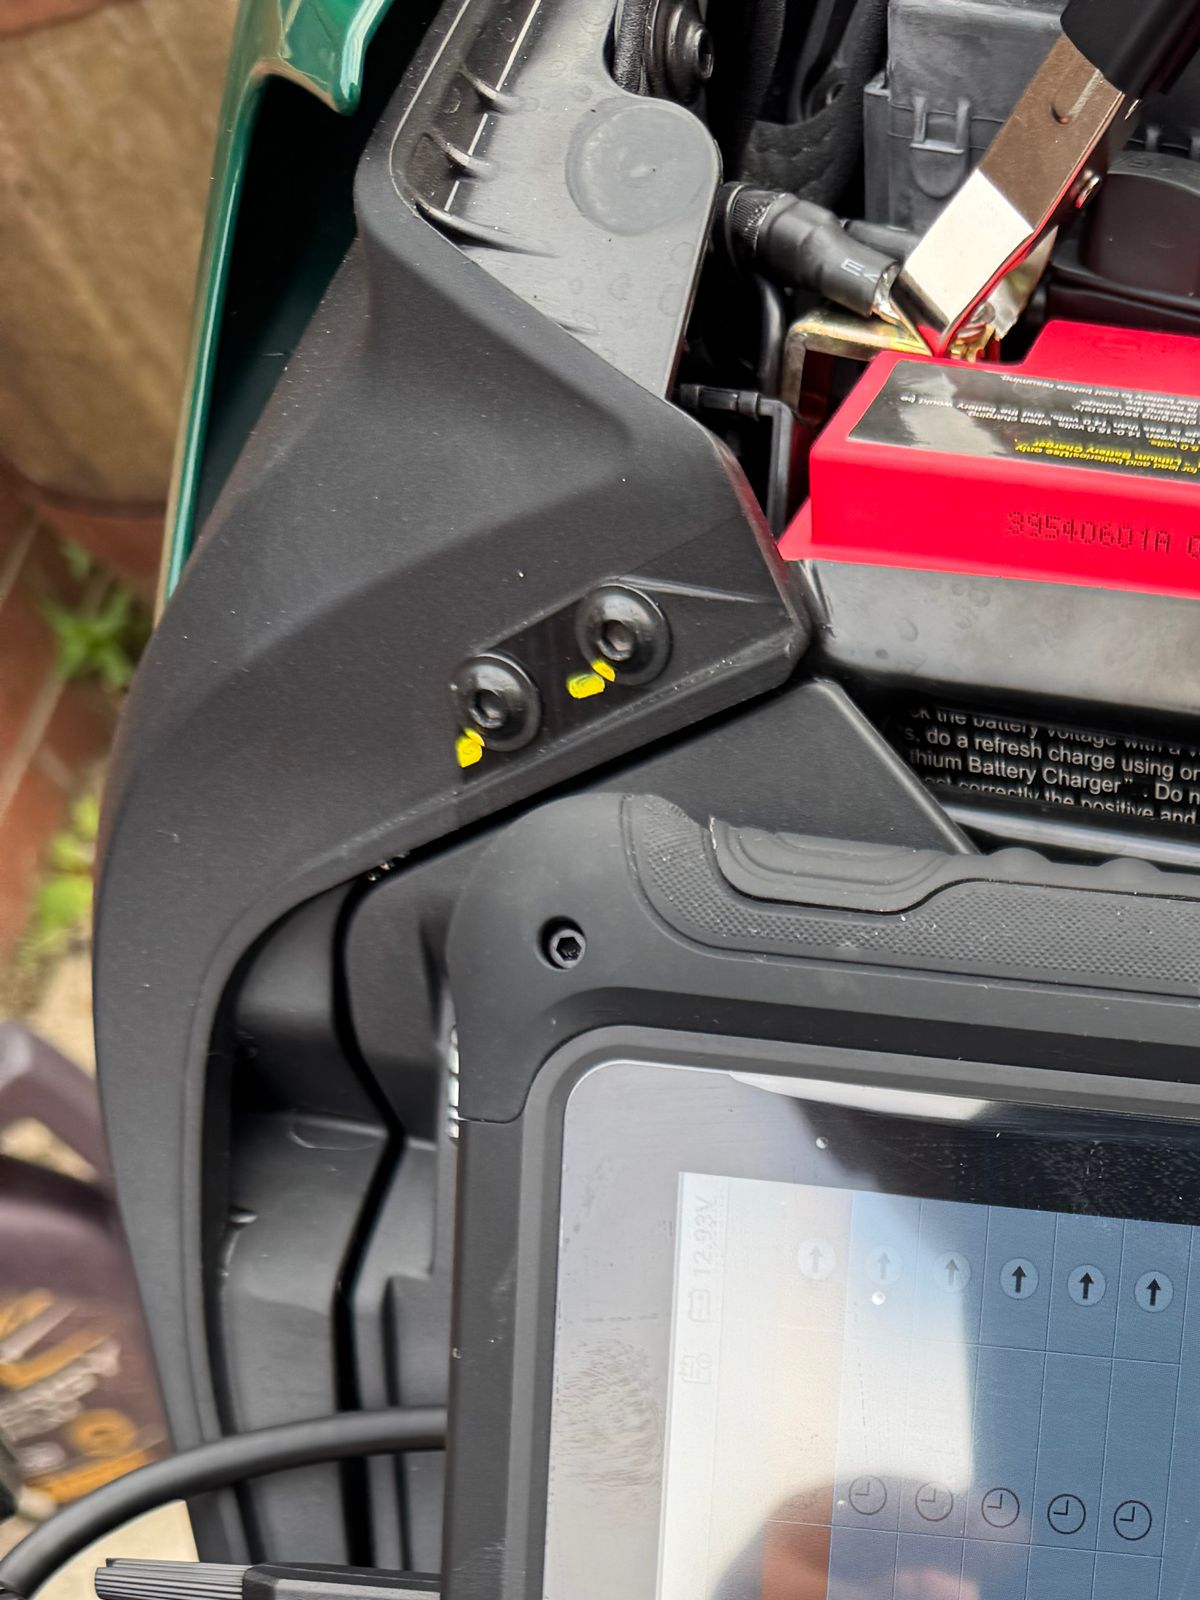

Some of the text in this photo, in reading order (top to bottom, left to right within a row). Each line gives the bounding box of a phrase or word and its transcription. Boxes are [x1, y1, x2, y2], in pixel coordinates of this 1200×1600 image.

[918, 397, 953, 408] would
[956, 401, 995, 412] battery
[1019, 417, 1051, 426] when
[1144, 432, 1195, 444] between
[1014, 444, 1042, 454] only
[1031, 440, 1082, 452] Charger
[1085, 446, 1131, 459] Battery
[1124, 459, 1150, 468] acid
[1133, 453, 1181, 465] Lithium
[1152, 462, 1179, 471] lead
[1180, 465, 1196, 473] for
[927, 727, 951, 747] do
[956, 734, 969, 749] a
[974, 735, 1042, 760] refresh
[1048, 747, 1115, 773] charge
[1122, 758, 1174, 783] using
[968, 756, 1037, 785] Battery
[1154, 782, 1183, 802] Do
[1160, 805, 1197, 825] and
